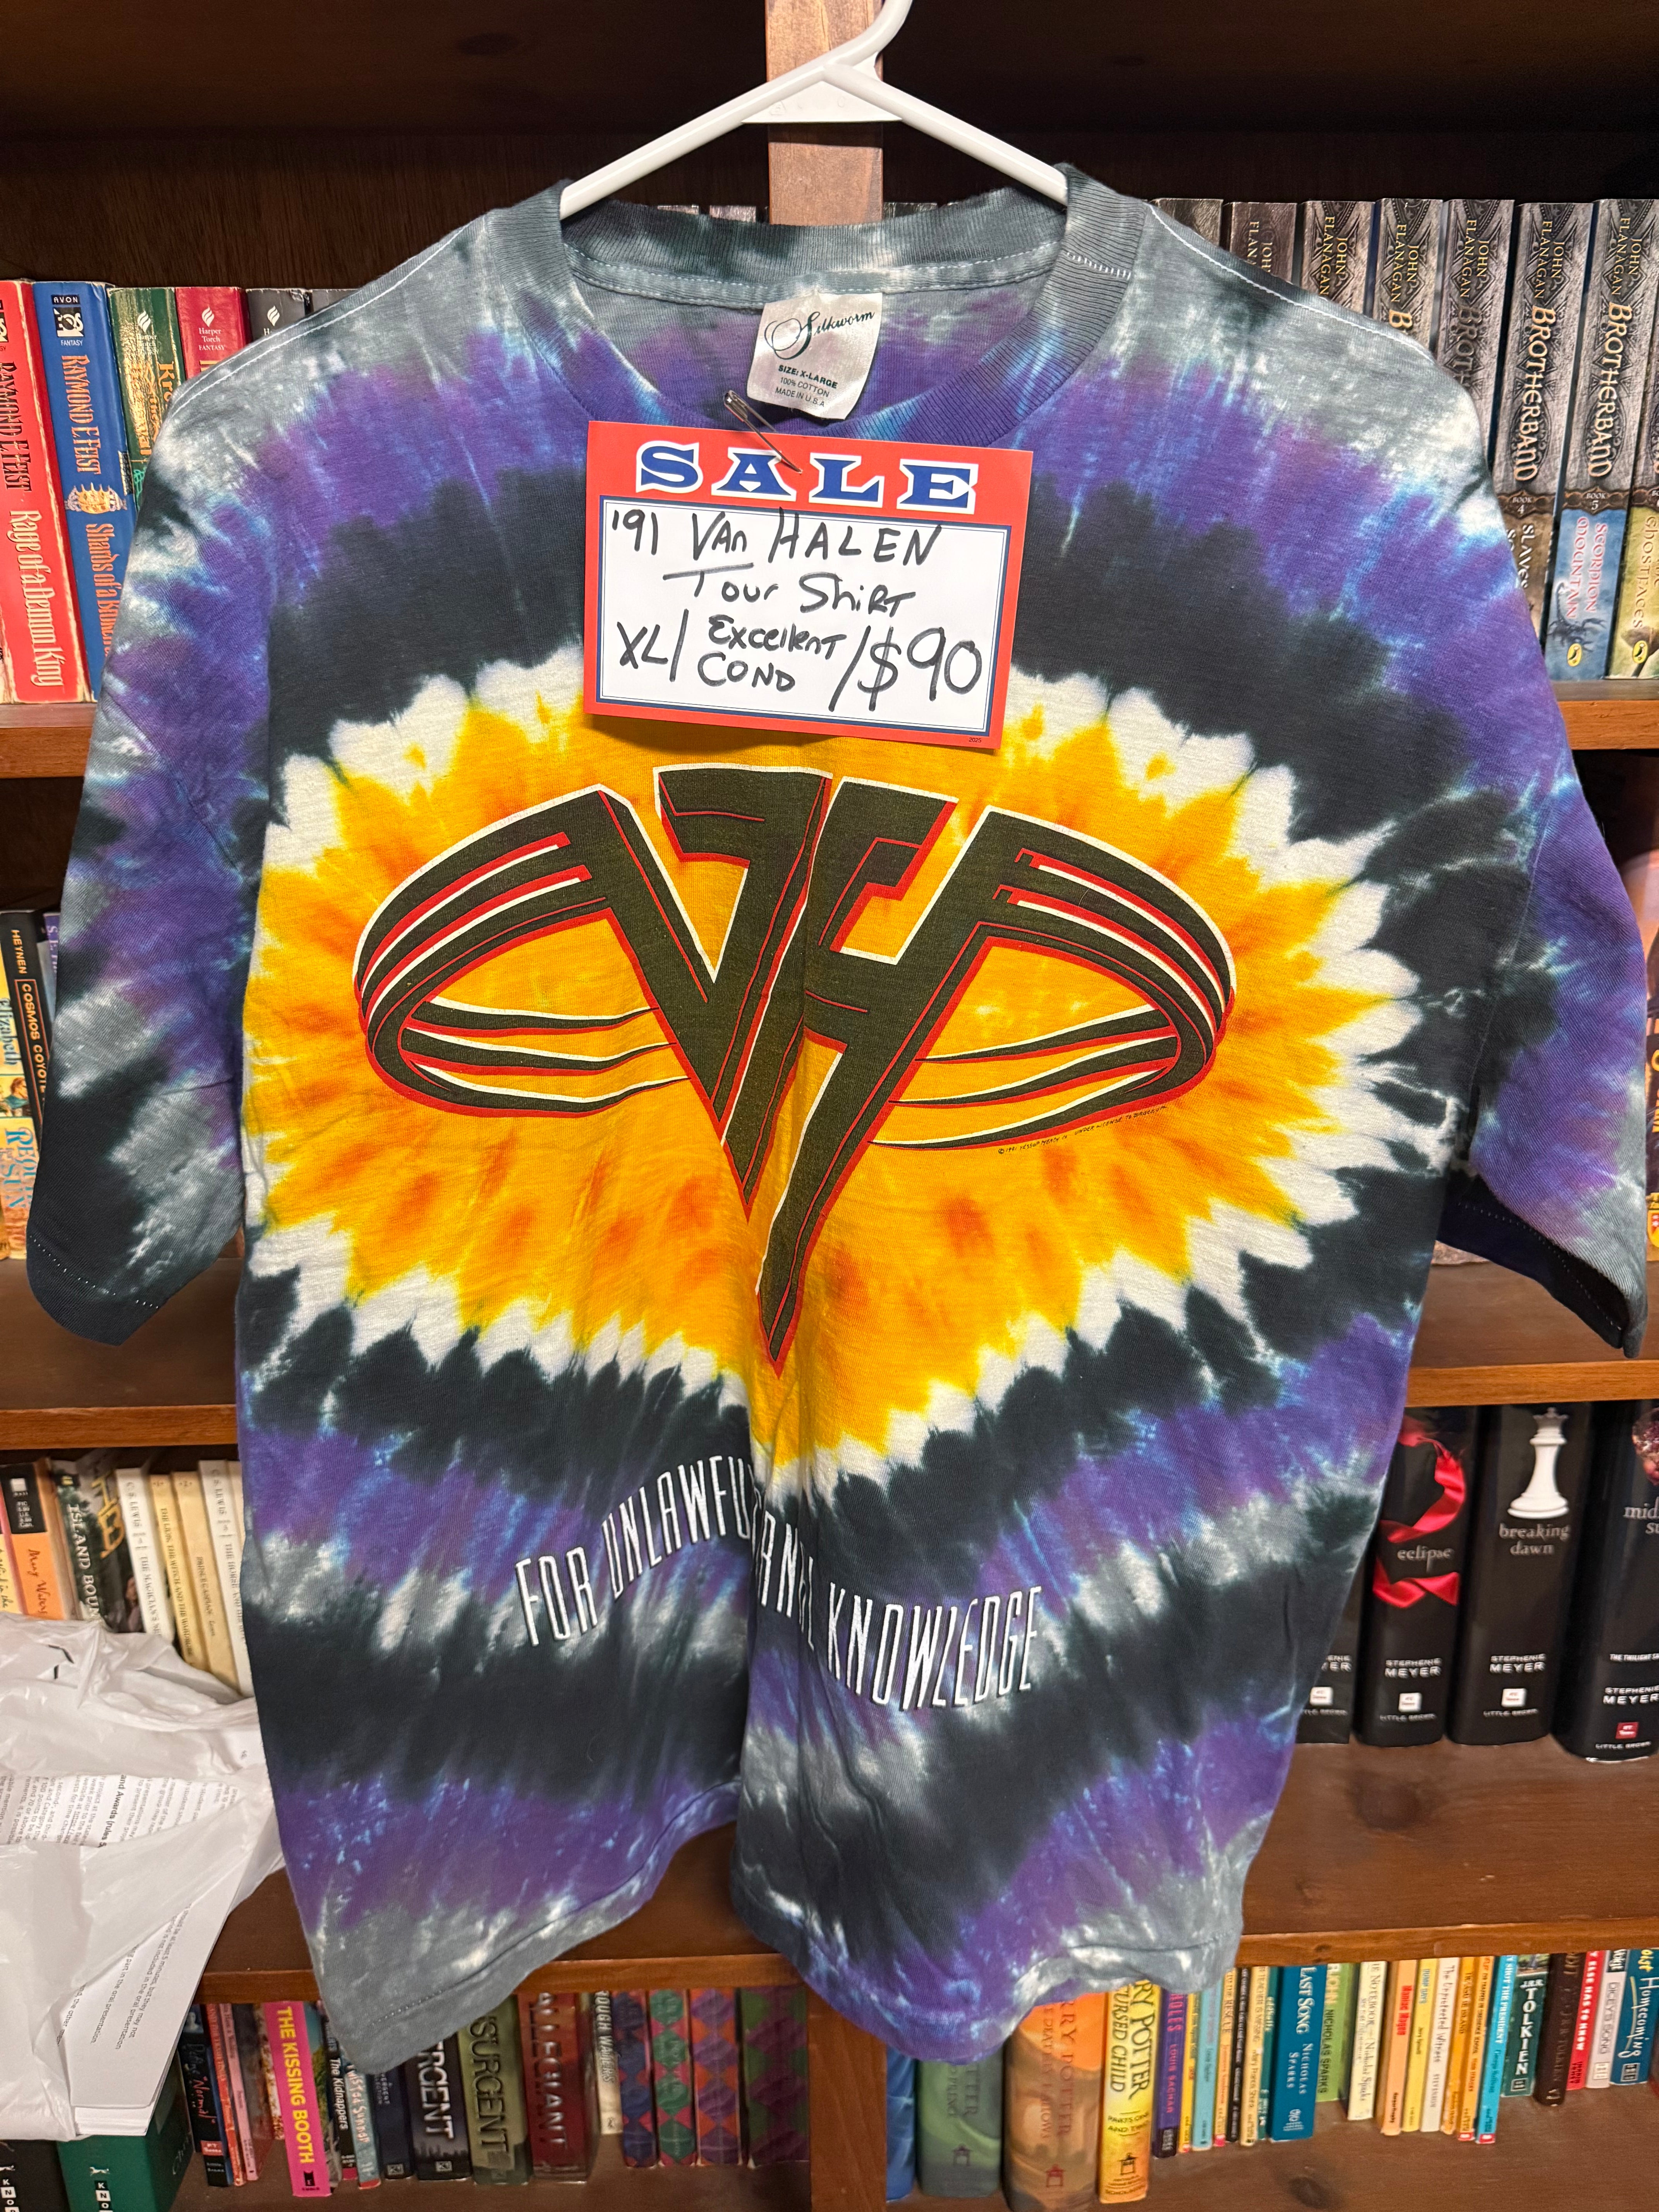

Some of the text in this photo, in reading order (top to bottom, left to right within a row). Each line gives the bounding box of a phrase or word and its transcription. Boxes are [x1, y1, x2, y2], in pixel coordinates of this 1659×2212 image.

[1319, 216, 1335, 296] FLANAGAN
[1335, 237, 1348, 275] JOHN
[1390, 223, 1407, 302] FLANAGAN
[1407, 244, 1419, 283] JOHN
[1460, 219, 1477, 298] FLANAGAN
[1476, 240, 1489, 278] JOHN
[1534, 220, 1553, 300] FLANAGAN
[1551, 241, 1565, 279] JOHN
[1611, 217, 1630, 296] FLANAGAN
[1628, 237, 1642, 276] JOHN
[199, 328, 221, 336] Harper
[764, 311, 875, 360] Silkworm
[62, 355, 94, 423] RAYMOND
[775, 386, 804, 400] MADE IN
[778, 364, 838, 389] SIZE: X-LARGE
[780, 376, 830, 398] 100% COTTON
[1513, 304, 1556, 481] BROTHERBAND
[1588, 301, 1633, 477] BROTHERBAND
[635, 440, 979, 515] SALE
[1517, 505, 1525, 514] 4
[1590, 501, 1599, 510] 5
[611, 508, 659, 555] '91
[768, 507, 943, 566] HALEN
[86, 523, 122, 598] Shards of a
[7, 510, 66, 687] Rage of a Demon King
[662, 562, 779, 603] Tour
[697, 650, 796, 692] COND
[11, 929, 27, 974] HEYNEN
[22, 983, 41, 1041] COSMOS
[1074, 1126, 1094, 1135] UNDER
[67, 1503, 91, 1570] ISLAND
[1499, 1522, 1571, 1540] breaking
[1510, 1541, 1554, 1555] dawn
[1397, 1546, 1454, 1573] eclipse
[515, 1546, 598, 1646] FOR
[601, 1455, 752, 1602] UNLAWFU
[828, 1582, 1042, 1712] KNOWLEDGE
[1384, 1666, 1442, 1678] MEYER
[1385, 1657, 1443, 1668] STEPHENIE
[1489, 1662, 1546, 1674] MEYER
[1490, 1653, 1547, 1664] STEPHENIE
[1602, 1693, 1659, 1704] MEYER
[101, 1774, 126, 1840] and Awards (rules
[109, 1959, 132, 2002] part the oral
[1443, 1965, 1455, 1980] The
[1503, 1963, 1515, 1985] SHOT
[1587, 1961, 1597, 1983] ELSE
[63, 1998, 79, 2027] the other
[116, 1949, 163, 2049] included the oral presentation
[1295, 1967, 1316, 2035] LAST SONG
[1367, 1974, 1381, 2026] NOTEBOOK
[1437, 1983, 1453, 2030] Unprotected
[1500, 1985, 1511, 2001] THE
[1582, 1986, 1594, 2006] HAS
[133, 2013, 143, 2025] may
[1222, 2000, 1234, 2034] RESCUE
[1322, 2009, 1335, 2057] NICHOLAS
[1459, 2009, 1468, 2035] ISLAND
[1515, 1987, 1537, 2075] TOLKIEN
[1581, 2008, 1590, 2021] TO
[1618, 1977, 1659, 2058] Homecoming
[599, 2035, 615, 2083] WATERS
[1128, 2009, 1156, 2100] POTTER
[1361, 2041, 1375, 2075] Nicholas
[1432, 2033, 1446, 2063] Witness
[1600, 2024, 1614, 2055] SONG
[276, 2006, 315, 2164] THE KISSING BOOTH
[329, 2057, 342, 2078] The
[1110, 2045, 1129, 2092] CHILD
[1286, 2052, 1300, 2089] SPARKS
[1298, 2043, 1314, 2095] NICHOLAS
[1317, 2058, 1332, 2094] SPARKS
[333, 2076, 349, 2130] Kidnappers
[1358, 2076, 1371, 2102] Sparks
